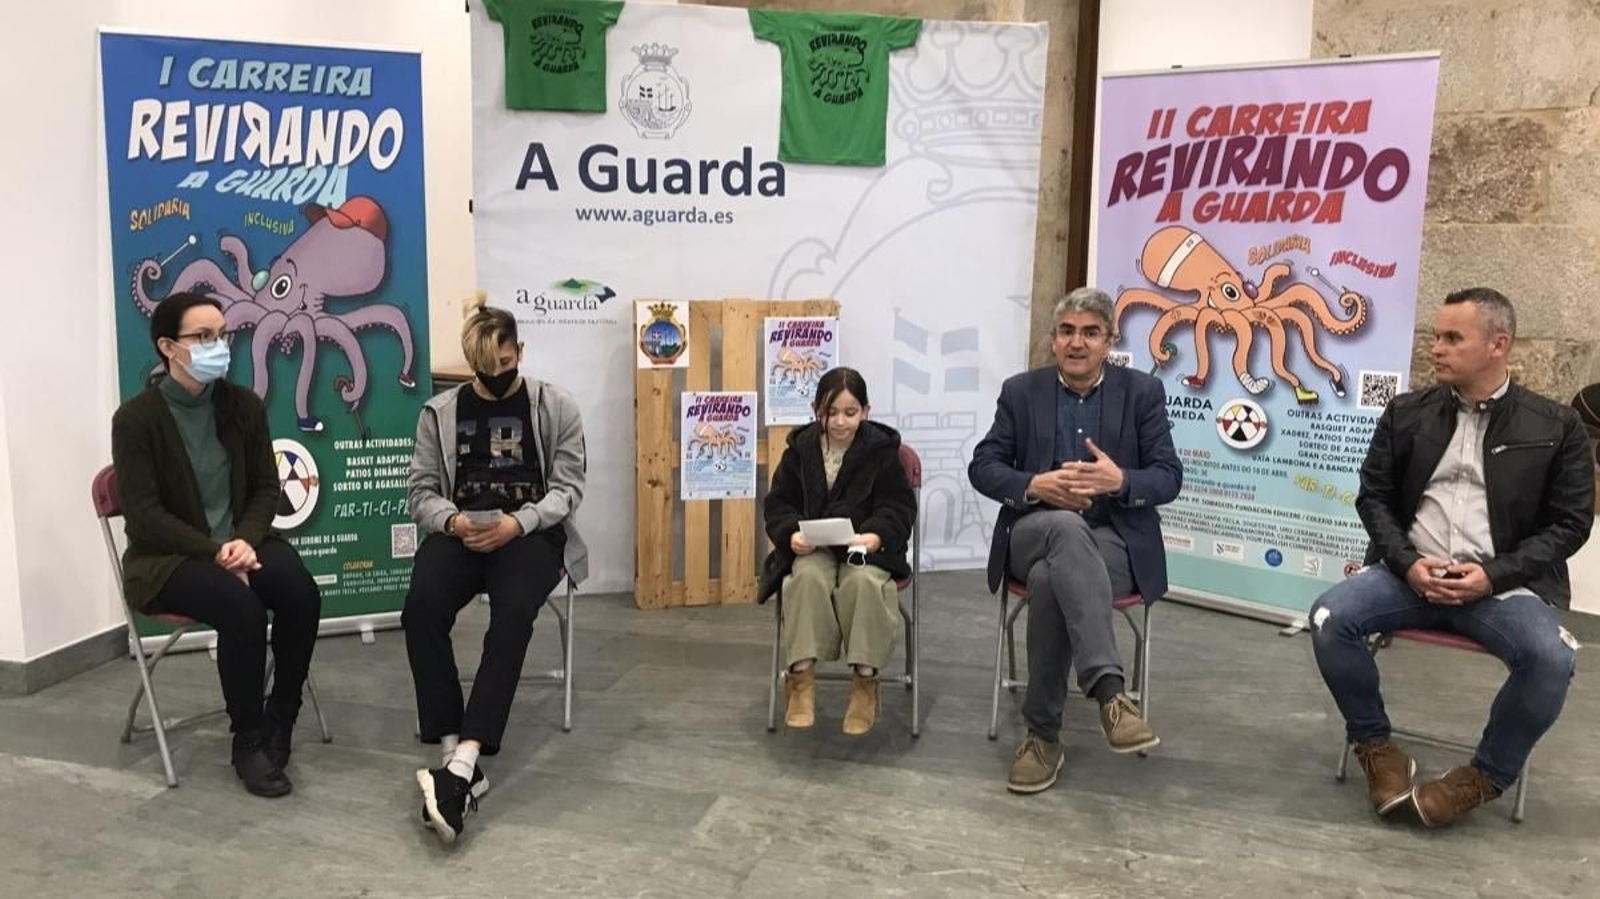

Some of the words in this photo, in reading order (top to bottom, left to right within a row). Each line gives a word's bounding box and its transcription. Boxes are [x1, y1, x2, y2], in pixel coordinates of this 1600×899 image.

[160, 56, 174, 86] I
[187, 58, 372, 97] CARREIRA
[823, 88, 863, 104] GUARDA
[1147, 108, 1178, 140] II
[1186, 98, 1372, 138] CARREIRA
[515, 142, 559, 191] A
[578, 144, 787, 198] Guarda
[1107, 135, 1410, 208] REVIRANDO
[177, 170, 209, 189] A
[214, 166, 349, 210] GUARDA
[130, 197, 190, 231] SOLIDARIA
[1156, 190, 1185, 224] A
[1192, 190, 1346, 224] GUARDA
[575, 205, 734, 227] www.aguarda.es
[244, 213, 294, 236] INCLUSIVA
[1248, 234, 1312, 266] SOLIDARIA
[1330, 250, 1396, 279] INCLUSIVA
[516, 289, 529, 304] a
[534, 295, 598, 316] guarda
[770, 330, 832, 344] REVIRANDO
[686, 403, 751, 418] REVIRANDO
[1287, 408, 1322, 420] OUTRAS
[1310, 423, 1346, 432] BASQUET
[334, 439, 363, 450] OUTRAS
[1314, 432, 1342, 442] PATIOS
[1300, 441, 1328, 450] SORTEO
[1330, 444, 1340, 452] DE
[347, 456, 373, 467] BASKET
[1298, 450, 1320, 460] GRAN
[346, 468, 372, 479] PATIOS
[1326, 464, 1354, 474] BANDA
[333, 481, 360, 492] SORTEO
[364, 481, 372, 490] DE
